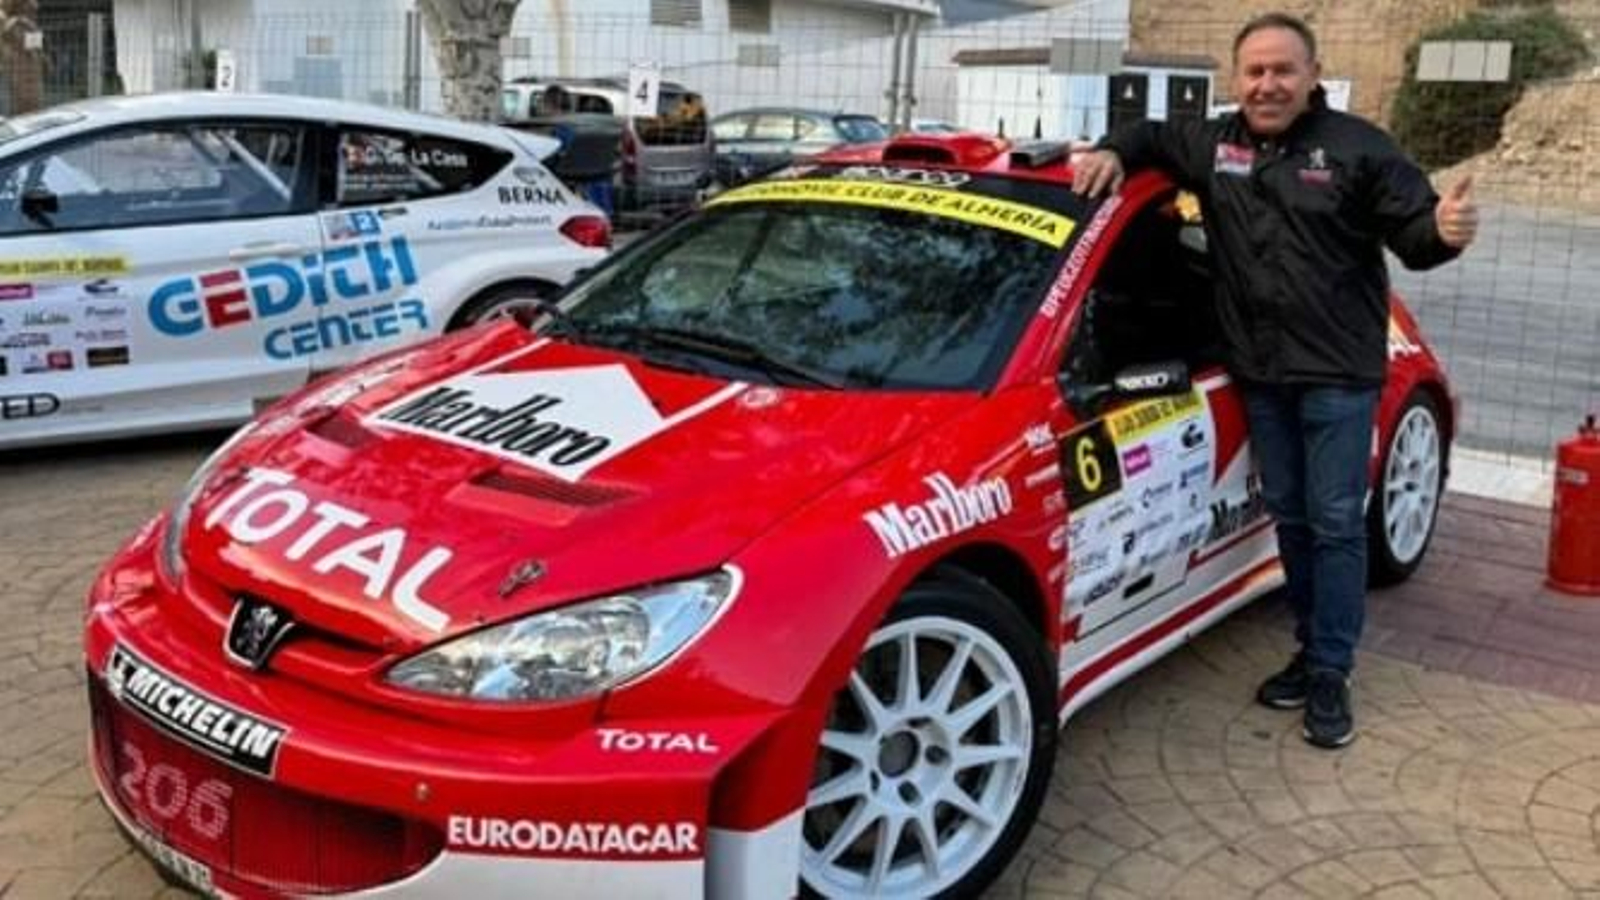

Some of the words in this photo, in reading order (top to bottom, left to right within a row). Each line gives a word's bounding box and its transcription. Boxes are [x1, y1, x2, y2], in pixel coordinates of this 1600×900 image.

[634, 79, 649, 105] 4
[498, 185, 567, 206] BERNA
[846, 184, 904, 199] CLUB
[908, 191, 945, 204] DE
[943, 196, 1056, 235] ALMERÍA
[0, 392, 60, 420] ED
[376, 386, 611, 466] Marlboro
[1075, 437, 1102, 491] 6
[862, 471, 1013, 559] Marlboro
[204, 467, 453, 634] TOTAL
[126, 667, 281, 759] MICHELIN
[119, 741, 233, 840] 206
[448, 815, 698, 852] EURODATACAR
